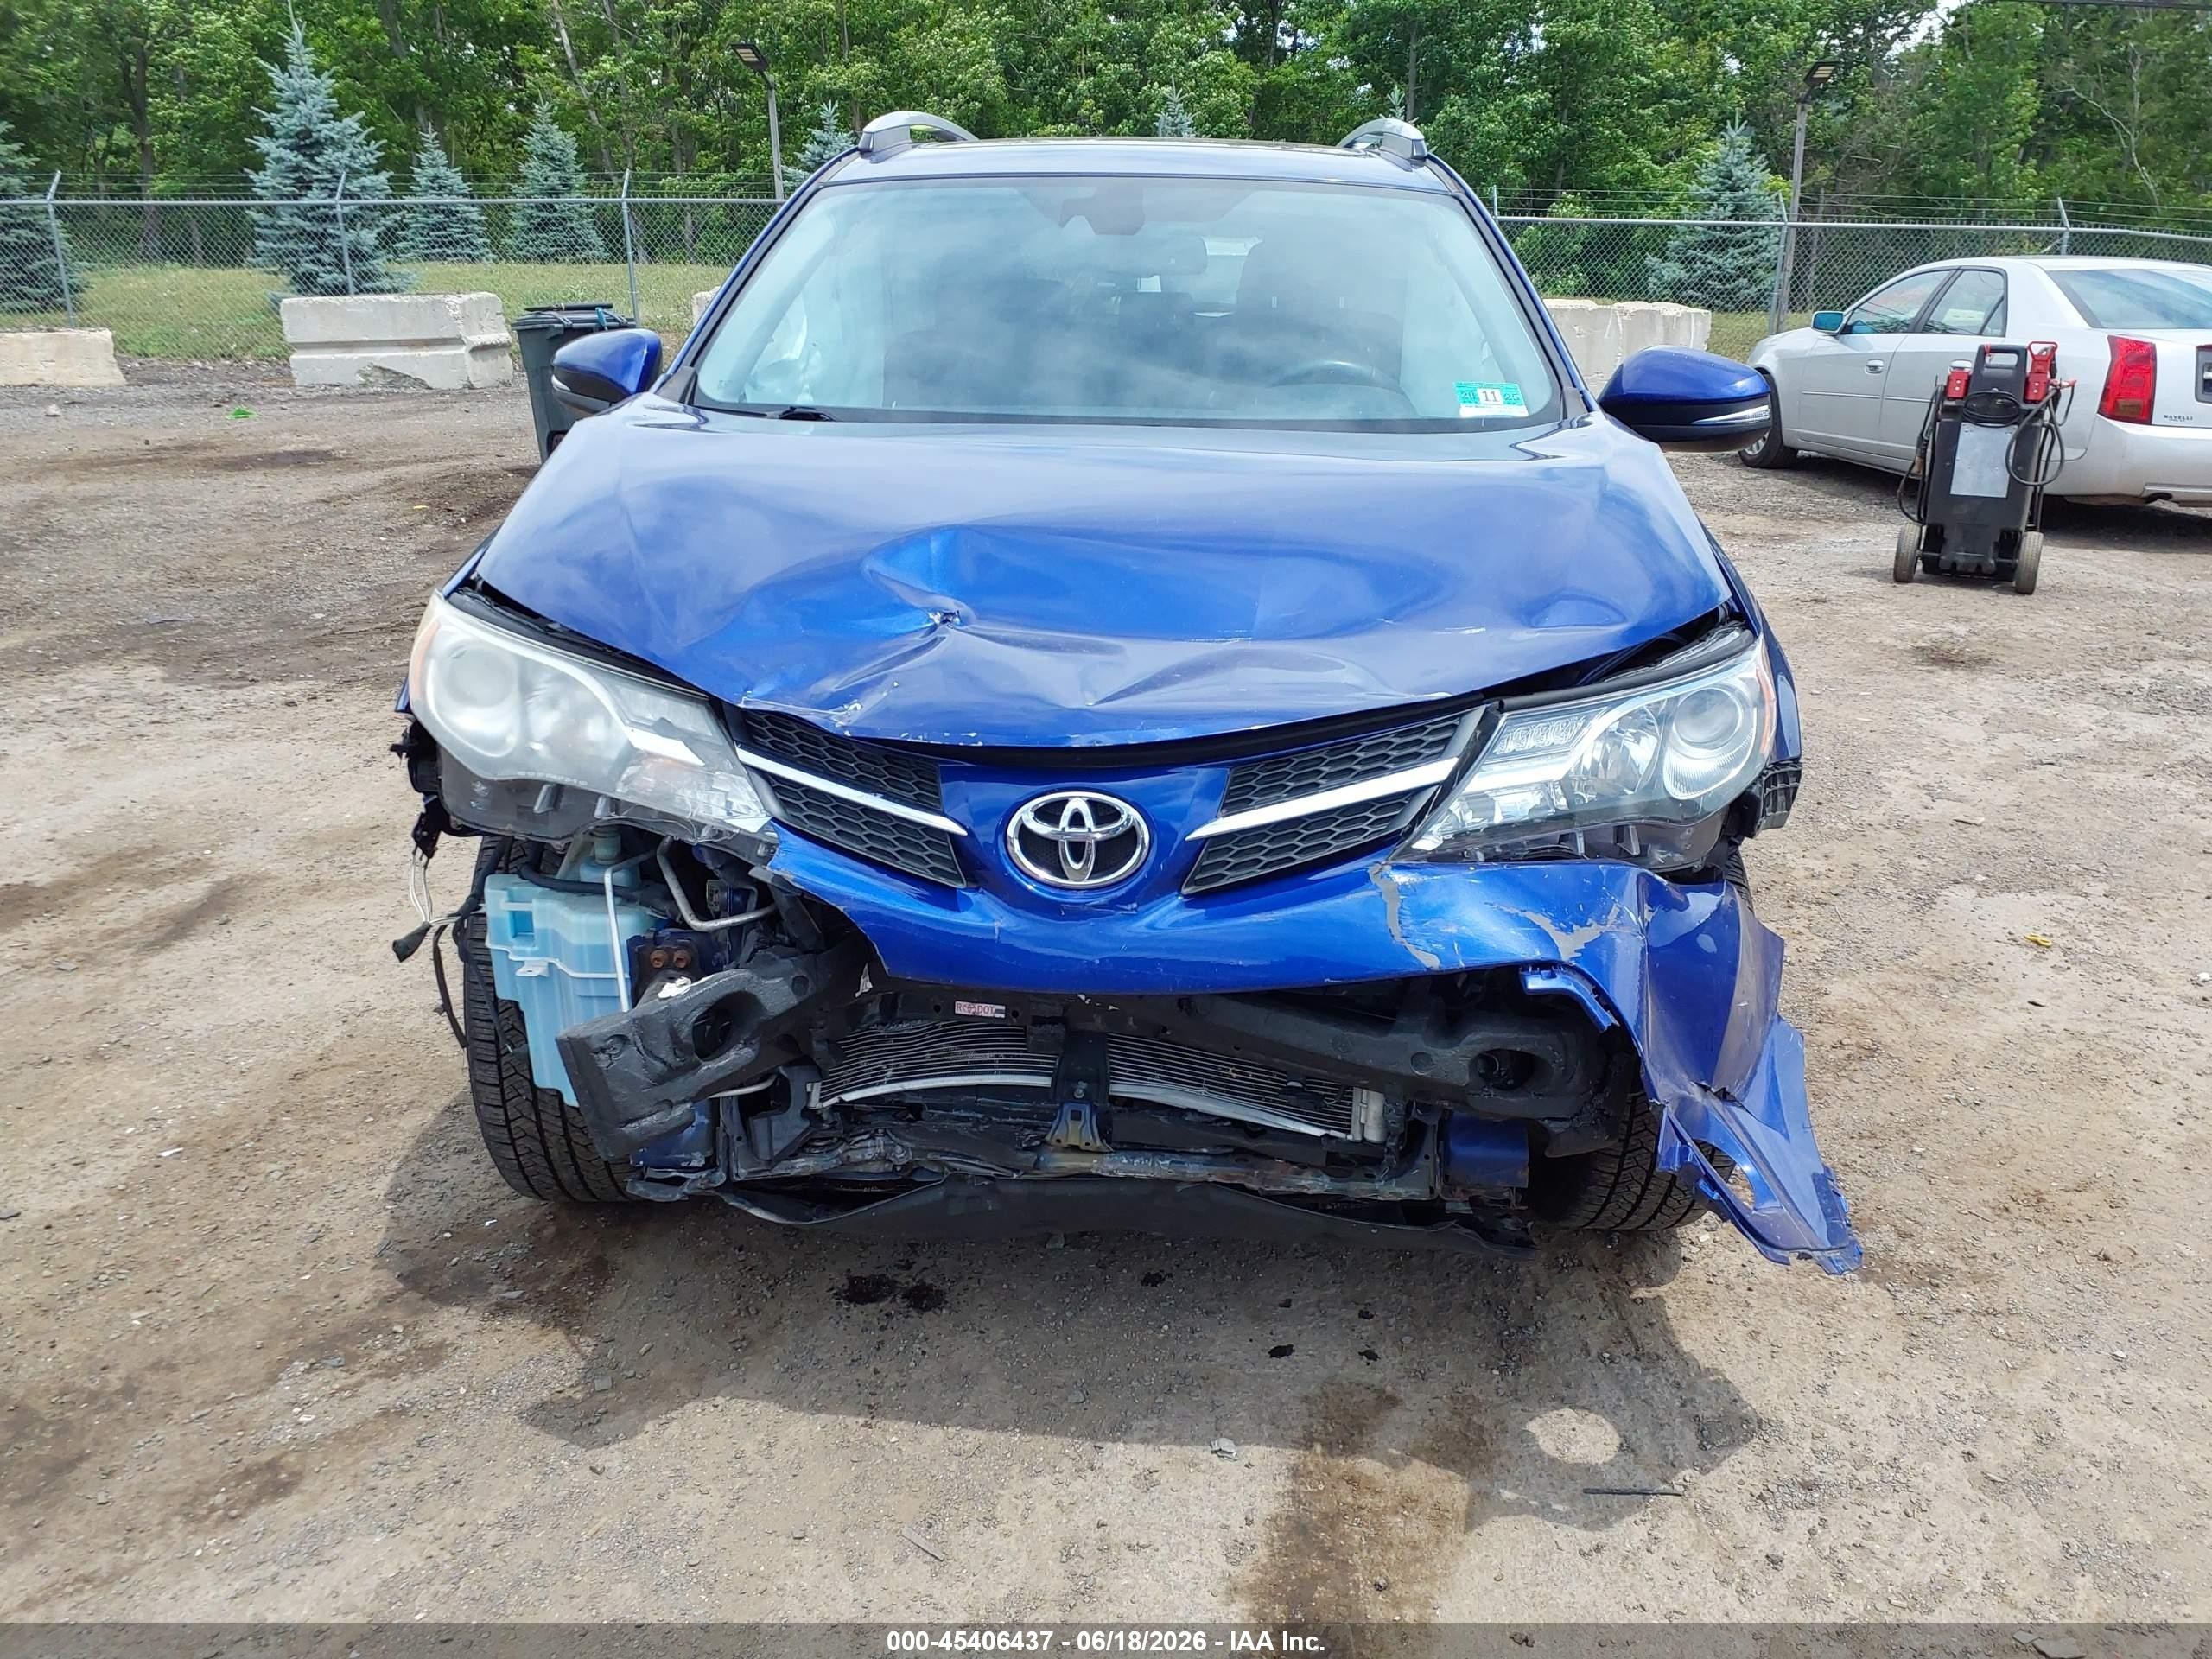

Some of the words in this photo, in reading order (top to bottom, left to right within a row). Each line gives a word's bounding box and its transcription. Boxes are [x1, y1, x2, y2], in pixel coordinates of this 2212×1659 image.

[1482, 390, 1499, 402] 11
[956, 1002, 963, 1013] R
[976, 1005, 995, 1014] DOT
